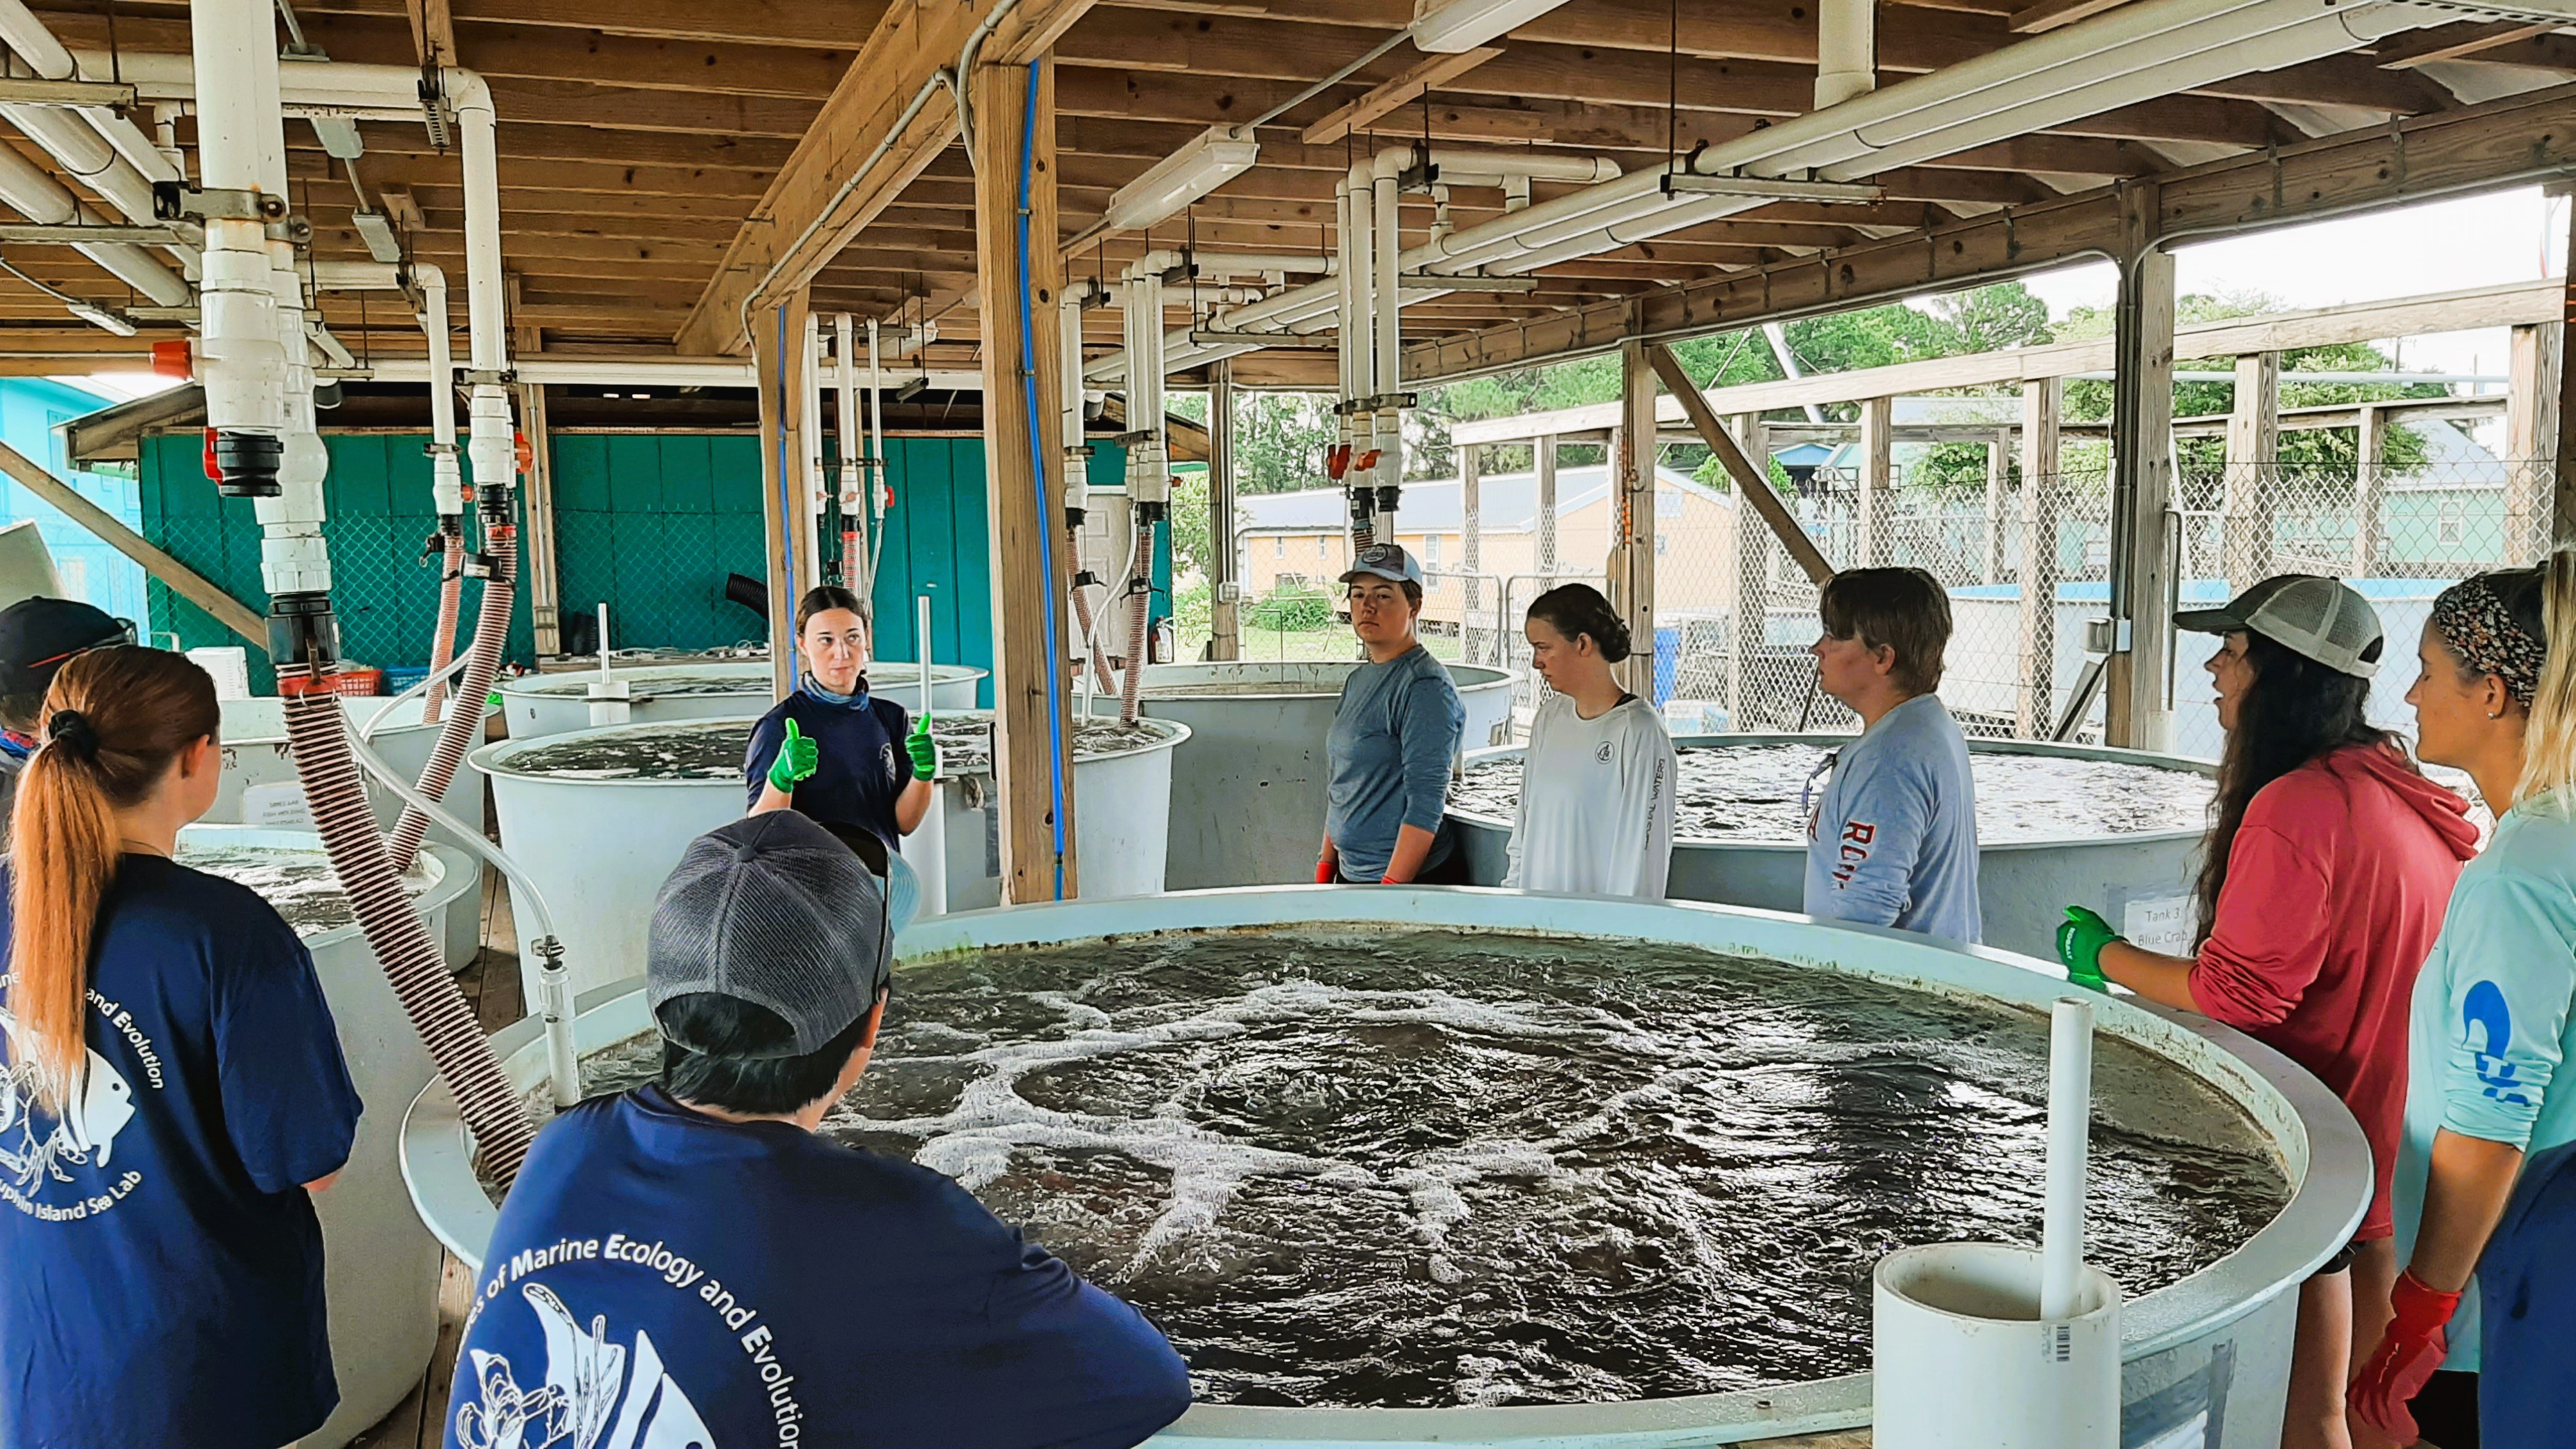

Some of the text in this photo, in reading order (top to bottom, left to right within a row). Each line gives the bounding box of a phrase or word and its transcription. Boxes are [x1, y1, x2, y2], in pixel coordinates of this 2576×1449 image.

[2138, 930, 2188, 946] Blue Crab
[2145, 910, 2171, 922] Tank
[86, 988, 119, 1016] and
[112, 1011, 164, 1089] Evolution
[35, 1200, 87, 1222] Island
[88, 1195, 113, 1214] Sea
[108, 1170, 142, 1199] Lab
[486, 1264, 507, 1298] of
[511, 1238, 599, 1282] Marine
[604, 1233, 704, 1288] Ecology
[700, 1279, 756, 1331] and
